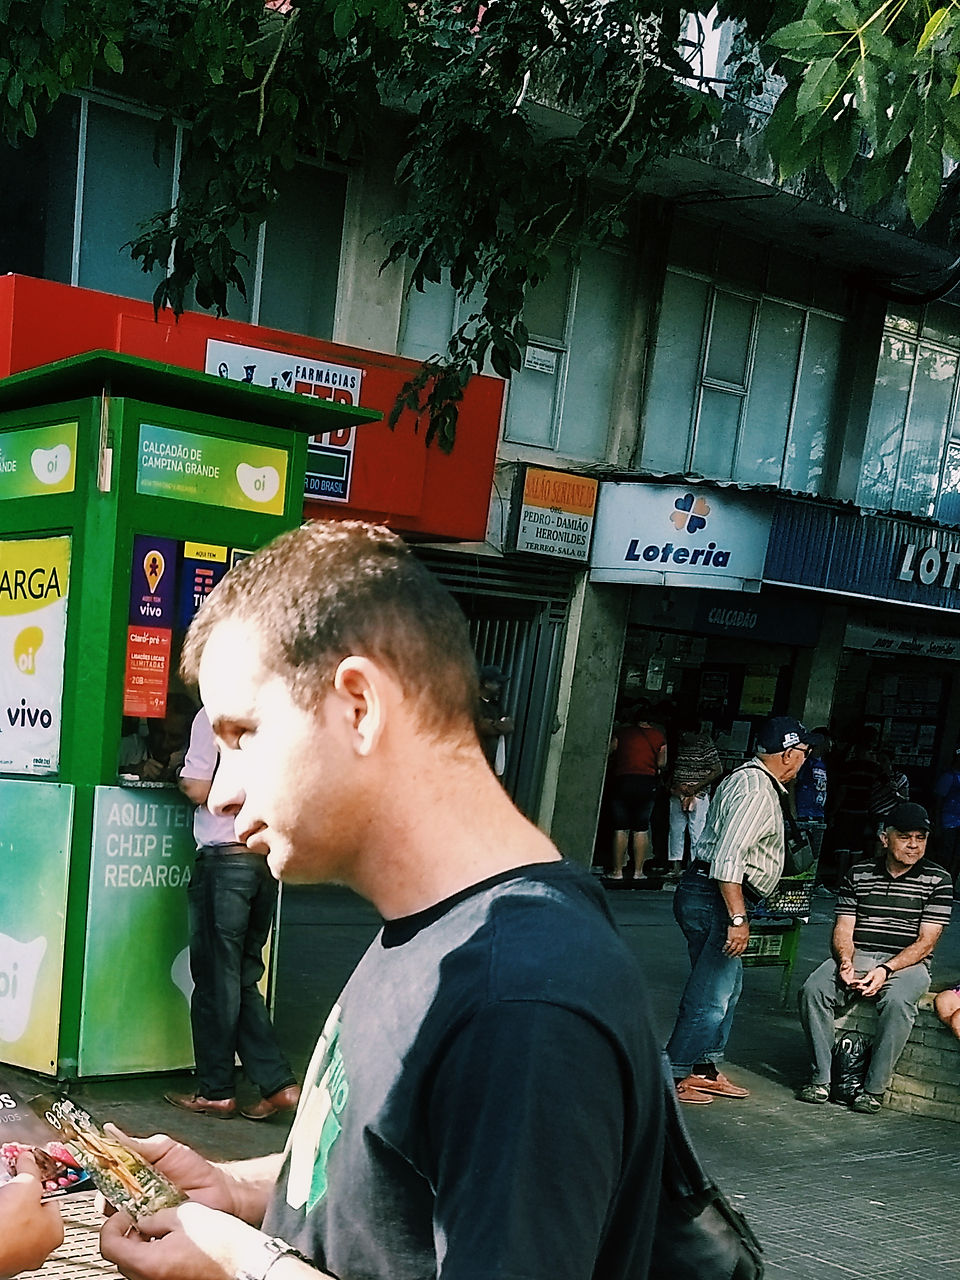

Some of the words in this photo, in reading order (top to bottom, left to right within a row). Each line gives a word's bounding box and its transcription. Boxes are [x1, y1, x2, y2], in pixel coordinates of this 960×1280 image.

[295, 365, 357, 388] FARMÁCIAS
[142, 440, 189, 459] CALÇADÃO
[190, 448, 202, 461] DE
[47, 455, 58, 473] oi
[141, 455, 183, 472] CAMPINA
[185, 462, 220, 479] GRANDE
[254, 475, 266, 492] oi
[309, 478, 321, 490] DO
[321, 479, 344, 494] BRASIL
[523, 510, 551, 526] PEDRO
[556, 516, 589, 533] DAMIÃO
[522, 526, 527, 534] E
[535, 526, 587, 546] HERONILDES
[625, 539, 731, 568] Loteria
[898, 543, 960, 589] LOT
[140, 603, 162, 617] vivo
[708, 608, 758, 630] CALÇADÃO
[18, 647, 33, 672] oi
[7, 698, 52, 729] vivo
[107, 802, 158, 827] AQUI
[106, 834, 157, 857] CHIP
[161, 835, 172, 857] E
[105, 864, 191, 888] RECARGA
